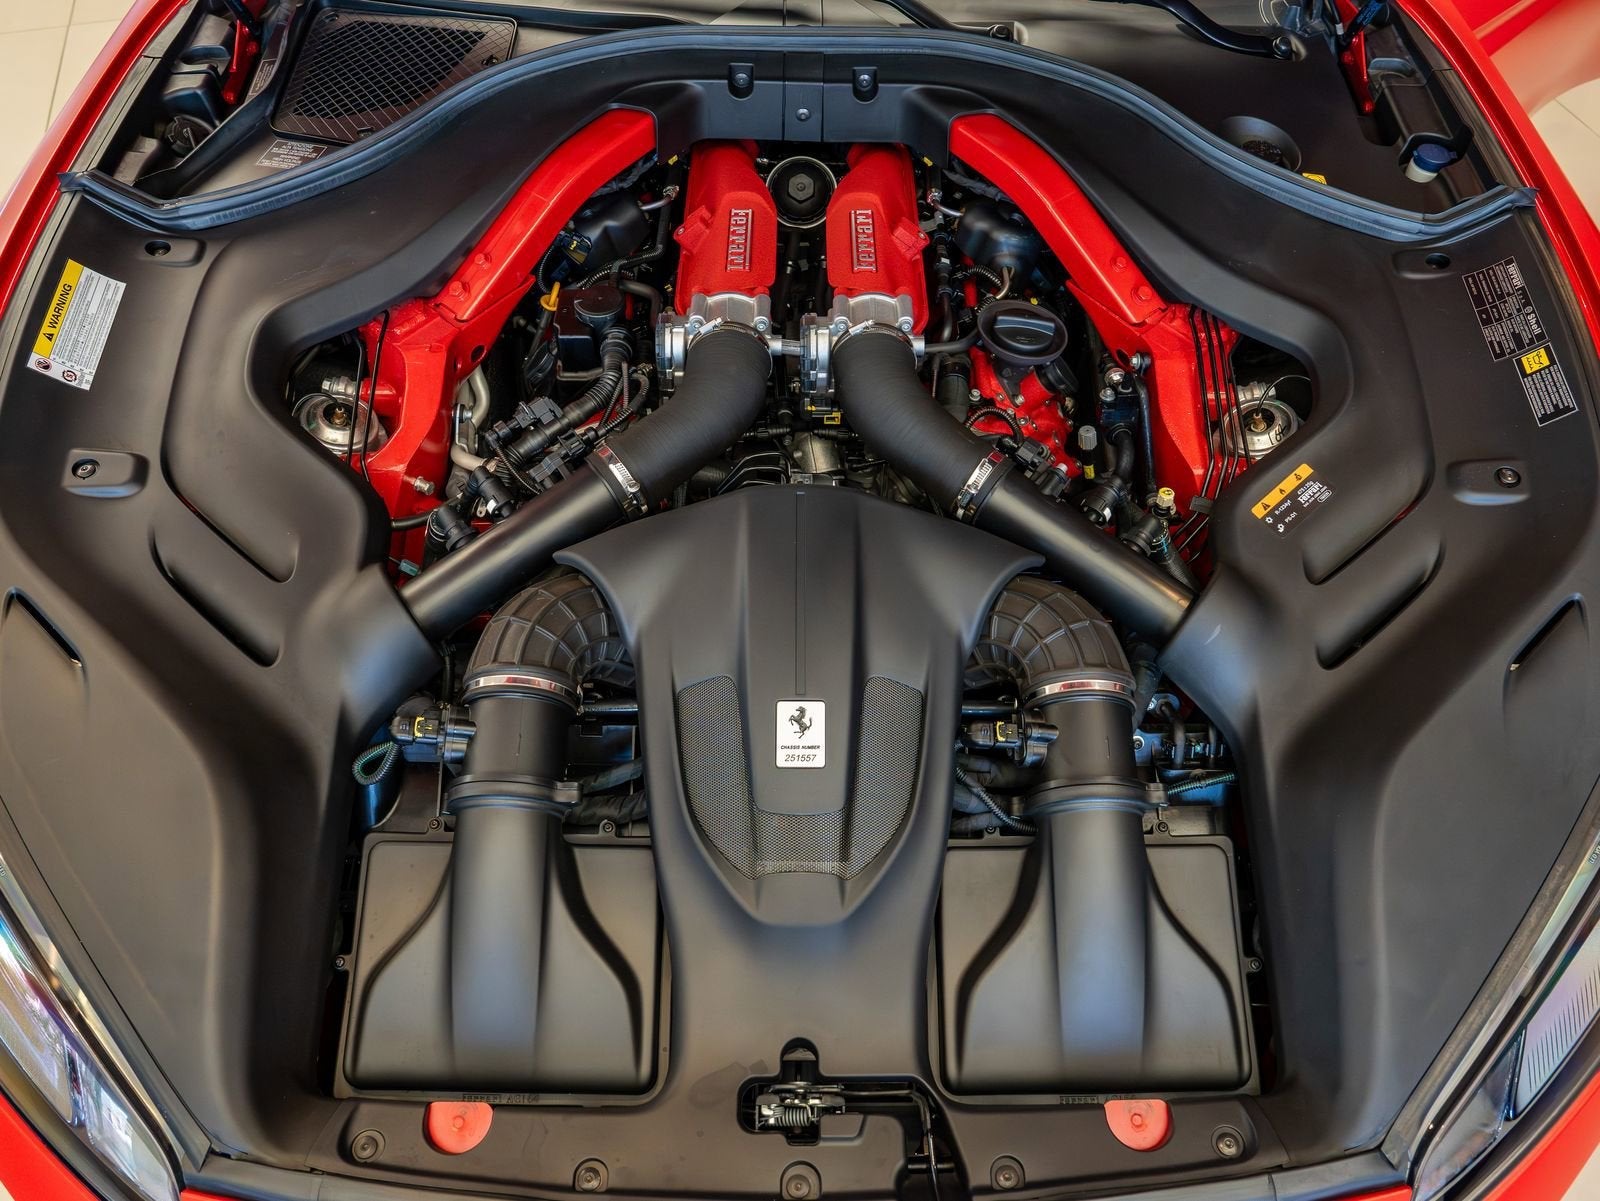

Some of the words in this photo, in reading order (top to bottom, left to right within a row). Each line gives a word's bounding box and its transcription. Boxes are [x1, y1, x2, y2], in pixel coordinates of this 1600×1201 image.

[727, 208, 752, 272] Ferrari
[851, 209, 877, 272] Ferrari
[48, 283, 73, 329] WARNING
[1506, 263, 1525, 290] Ferrari
[1527, 313, 1542, 335] Shell
[1298, 481, 1323, 504] Ferrari
[784, 753, 817, 762] 251557
